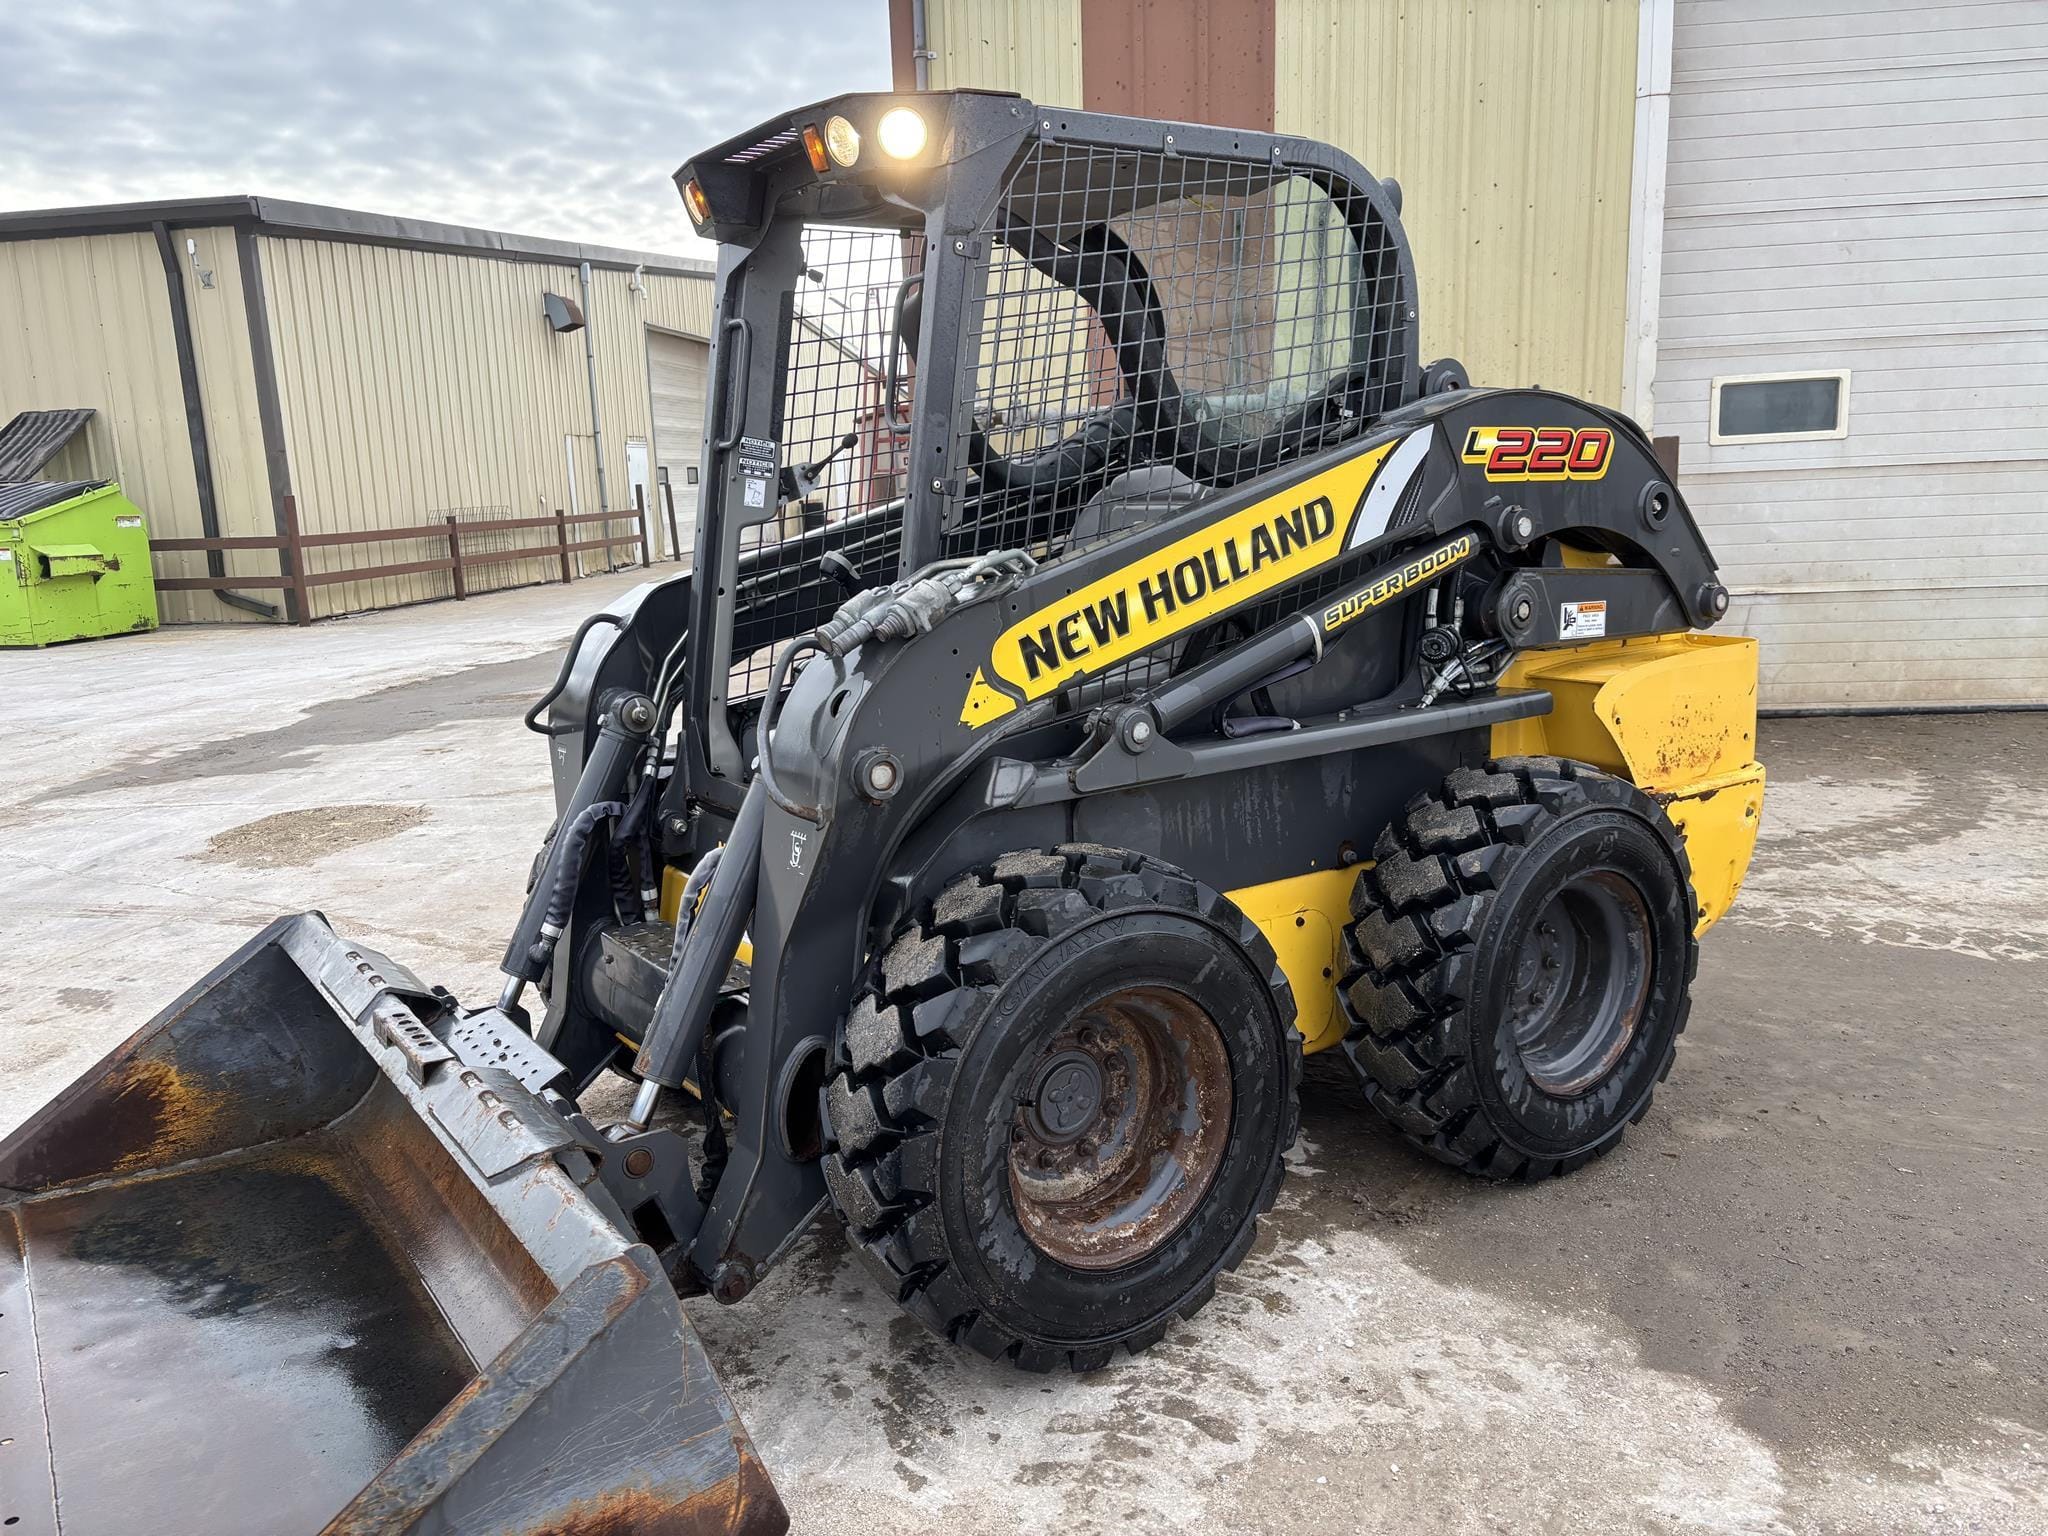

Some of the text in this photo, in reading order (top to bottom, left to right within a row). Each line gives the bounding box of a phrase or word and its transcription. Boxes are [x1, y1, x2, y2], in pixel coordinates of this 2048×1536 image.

[1461, 427, 1614, 480] L220
[1017, 494, 1336, 682] NEW HOLLAND
[1323, 536, 1472, 632] SUPER BOOM
[999, 918, 1127, 1017] GALAXY
